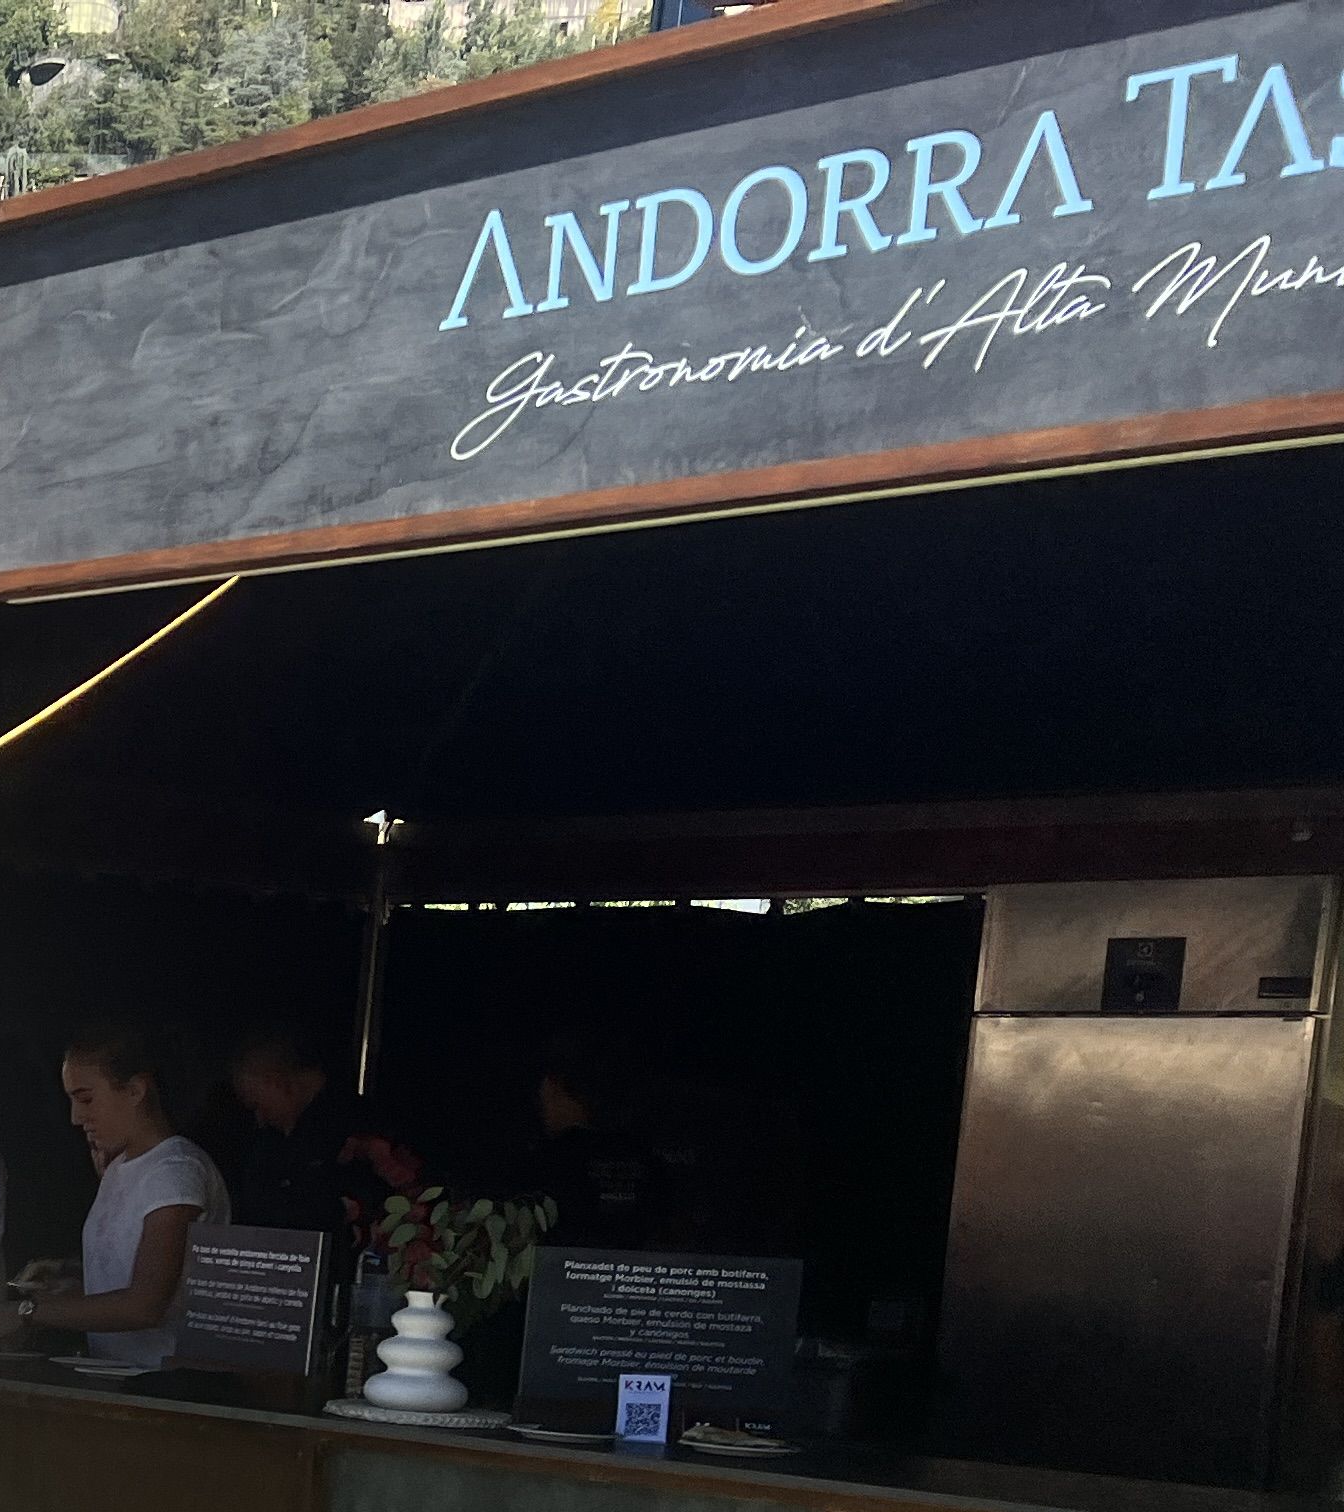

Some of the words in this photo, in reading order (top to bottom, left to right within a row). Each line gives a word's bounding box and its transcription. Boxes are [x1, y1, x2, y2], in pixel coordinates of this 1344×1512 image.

[439, 110, 1093, 332] ANDORRA
[1125, 53, 1344, 201] TA
[450, 326, 844, 461] Gastronomia
[855, 260, 1111, 375] d'Alta
[616, 1263, 630, 1272] de
[632, 1264, 652, 1275] peu
[655, 1265, 668, 1275] de
[670, 1266, 693, 1278] porc
[696, 1266, 719, 1277] amb
[565, 1271, 612, 1284] formatge
[659, 1275, 698, 1286] emulsió
[701, 1277, 715, 1287] de
[717, 1279, 766, 1290] mostassa
[618, 1284, 656, 1295] dolceta
[658, 1286, 716, 1299] (canonges)
[615, 1306, 628, 1316] de
[649, 1308, 662, 1318] de
[664, 1309, 693, 1320] cerdo
[646, 1317, 691, 1330] emulsión
[693, 1320, 707, 1331] de
[709, 1322, 752, 1332] mostaza
